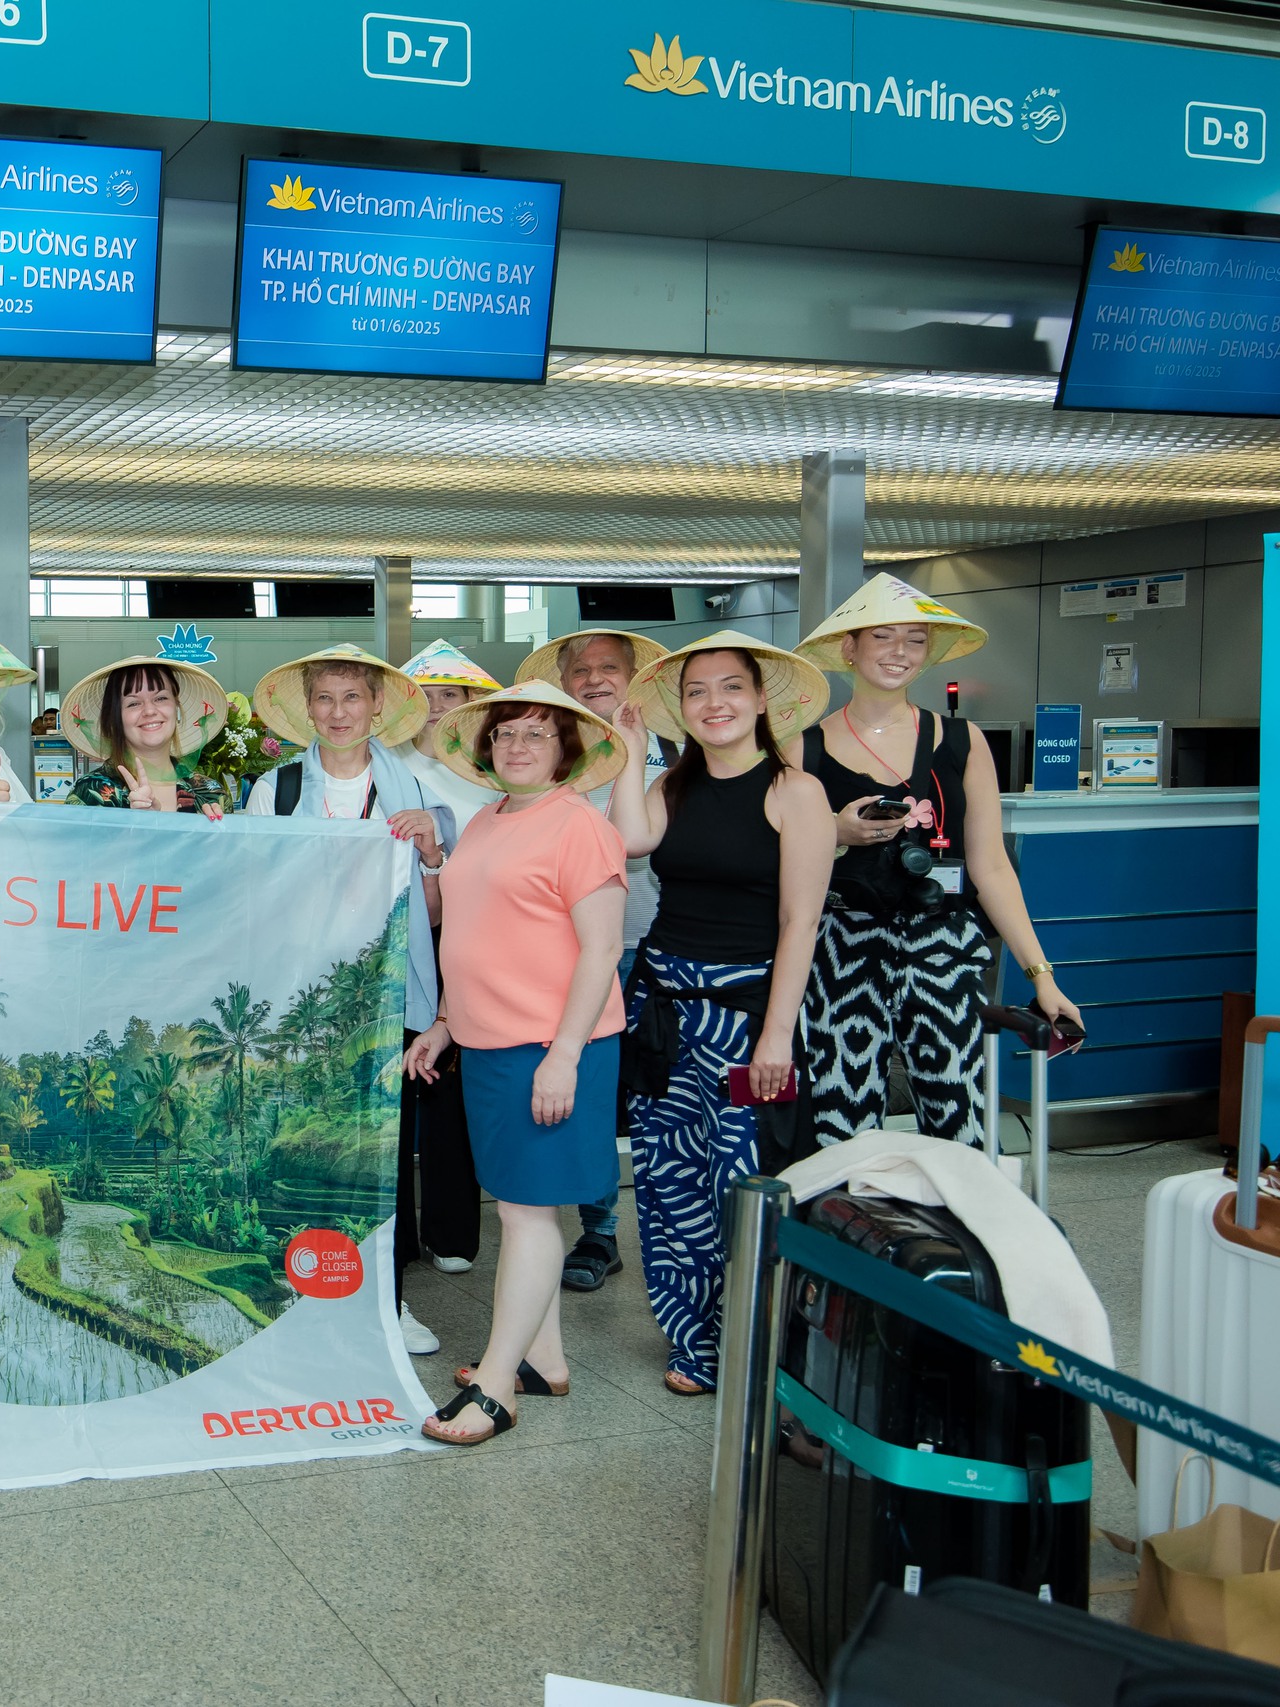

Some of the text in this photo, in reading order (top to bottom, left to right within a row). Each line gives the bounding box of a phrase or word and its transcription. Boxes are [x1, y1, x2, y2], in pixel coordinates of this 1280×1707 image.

[386, 30, 450, 69] D-7
[707, 56, 1014, 127] Vietnam Airlines
[1202, 116, 1249, 149] D-8
[0, 164, 99, 196] Airlines
[317, 187, 504, 226] Vietnam Airlines
[94, 237, 137, 260] BAY
[262, 247, 535, 286] KHAI TRƯƠNG ĐƯỜNG BAY
[1148, 253, 1220, 278] Vietnam
[23, 266, 135, 293] DENPASAR
[261, 279, 287, 302] TP.
[292, 276, 322, 304] HỒ
[326, 281, 361, 306] CHÍ
[364, 286, 417, 309] MINH
[432, 290, 531, 316] DENPASAR
[352, 317, 441, 335] từ 01/6/2025
[1096, 304, 1136, 325] KHAI
[1139, 307, 1206, 329] TRƯƠNG
[1209, 310, 1269, 332] ĐƯỜNG
[1091, 333, 1110, 352] TP.
[1140, 333, 1168, 354] CHÍ
[1169, 337, 1208, 356] MINH
[1168, 364, 1223, 378] 01/6/2025
[1037, 738, 1058, 748] ĐÓNG
[1043, 755, 1071, 763] CLOSED
[56, 879, 183, 934] LIVE
[322, 1251, 348, 1260] COME
[322, 1262, 358, 1272] CLOSER
[322, 1275, 350, 1283] CAMPUS
[202, 1398, 406, 1439] DERTOUR
[1057, 1359, 1255, 1462] Vietnam Airlines
[330, 1423, 414, 1441] GROUP
